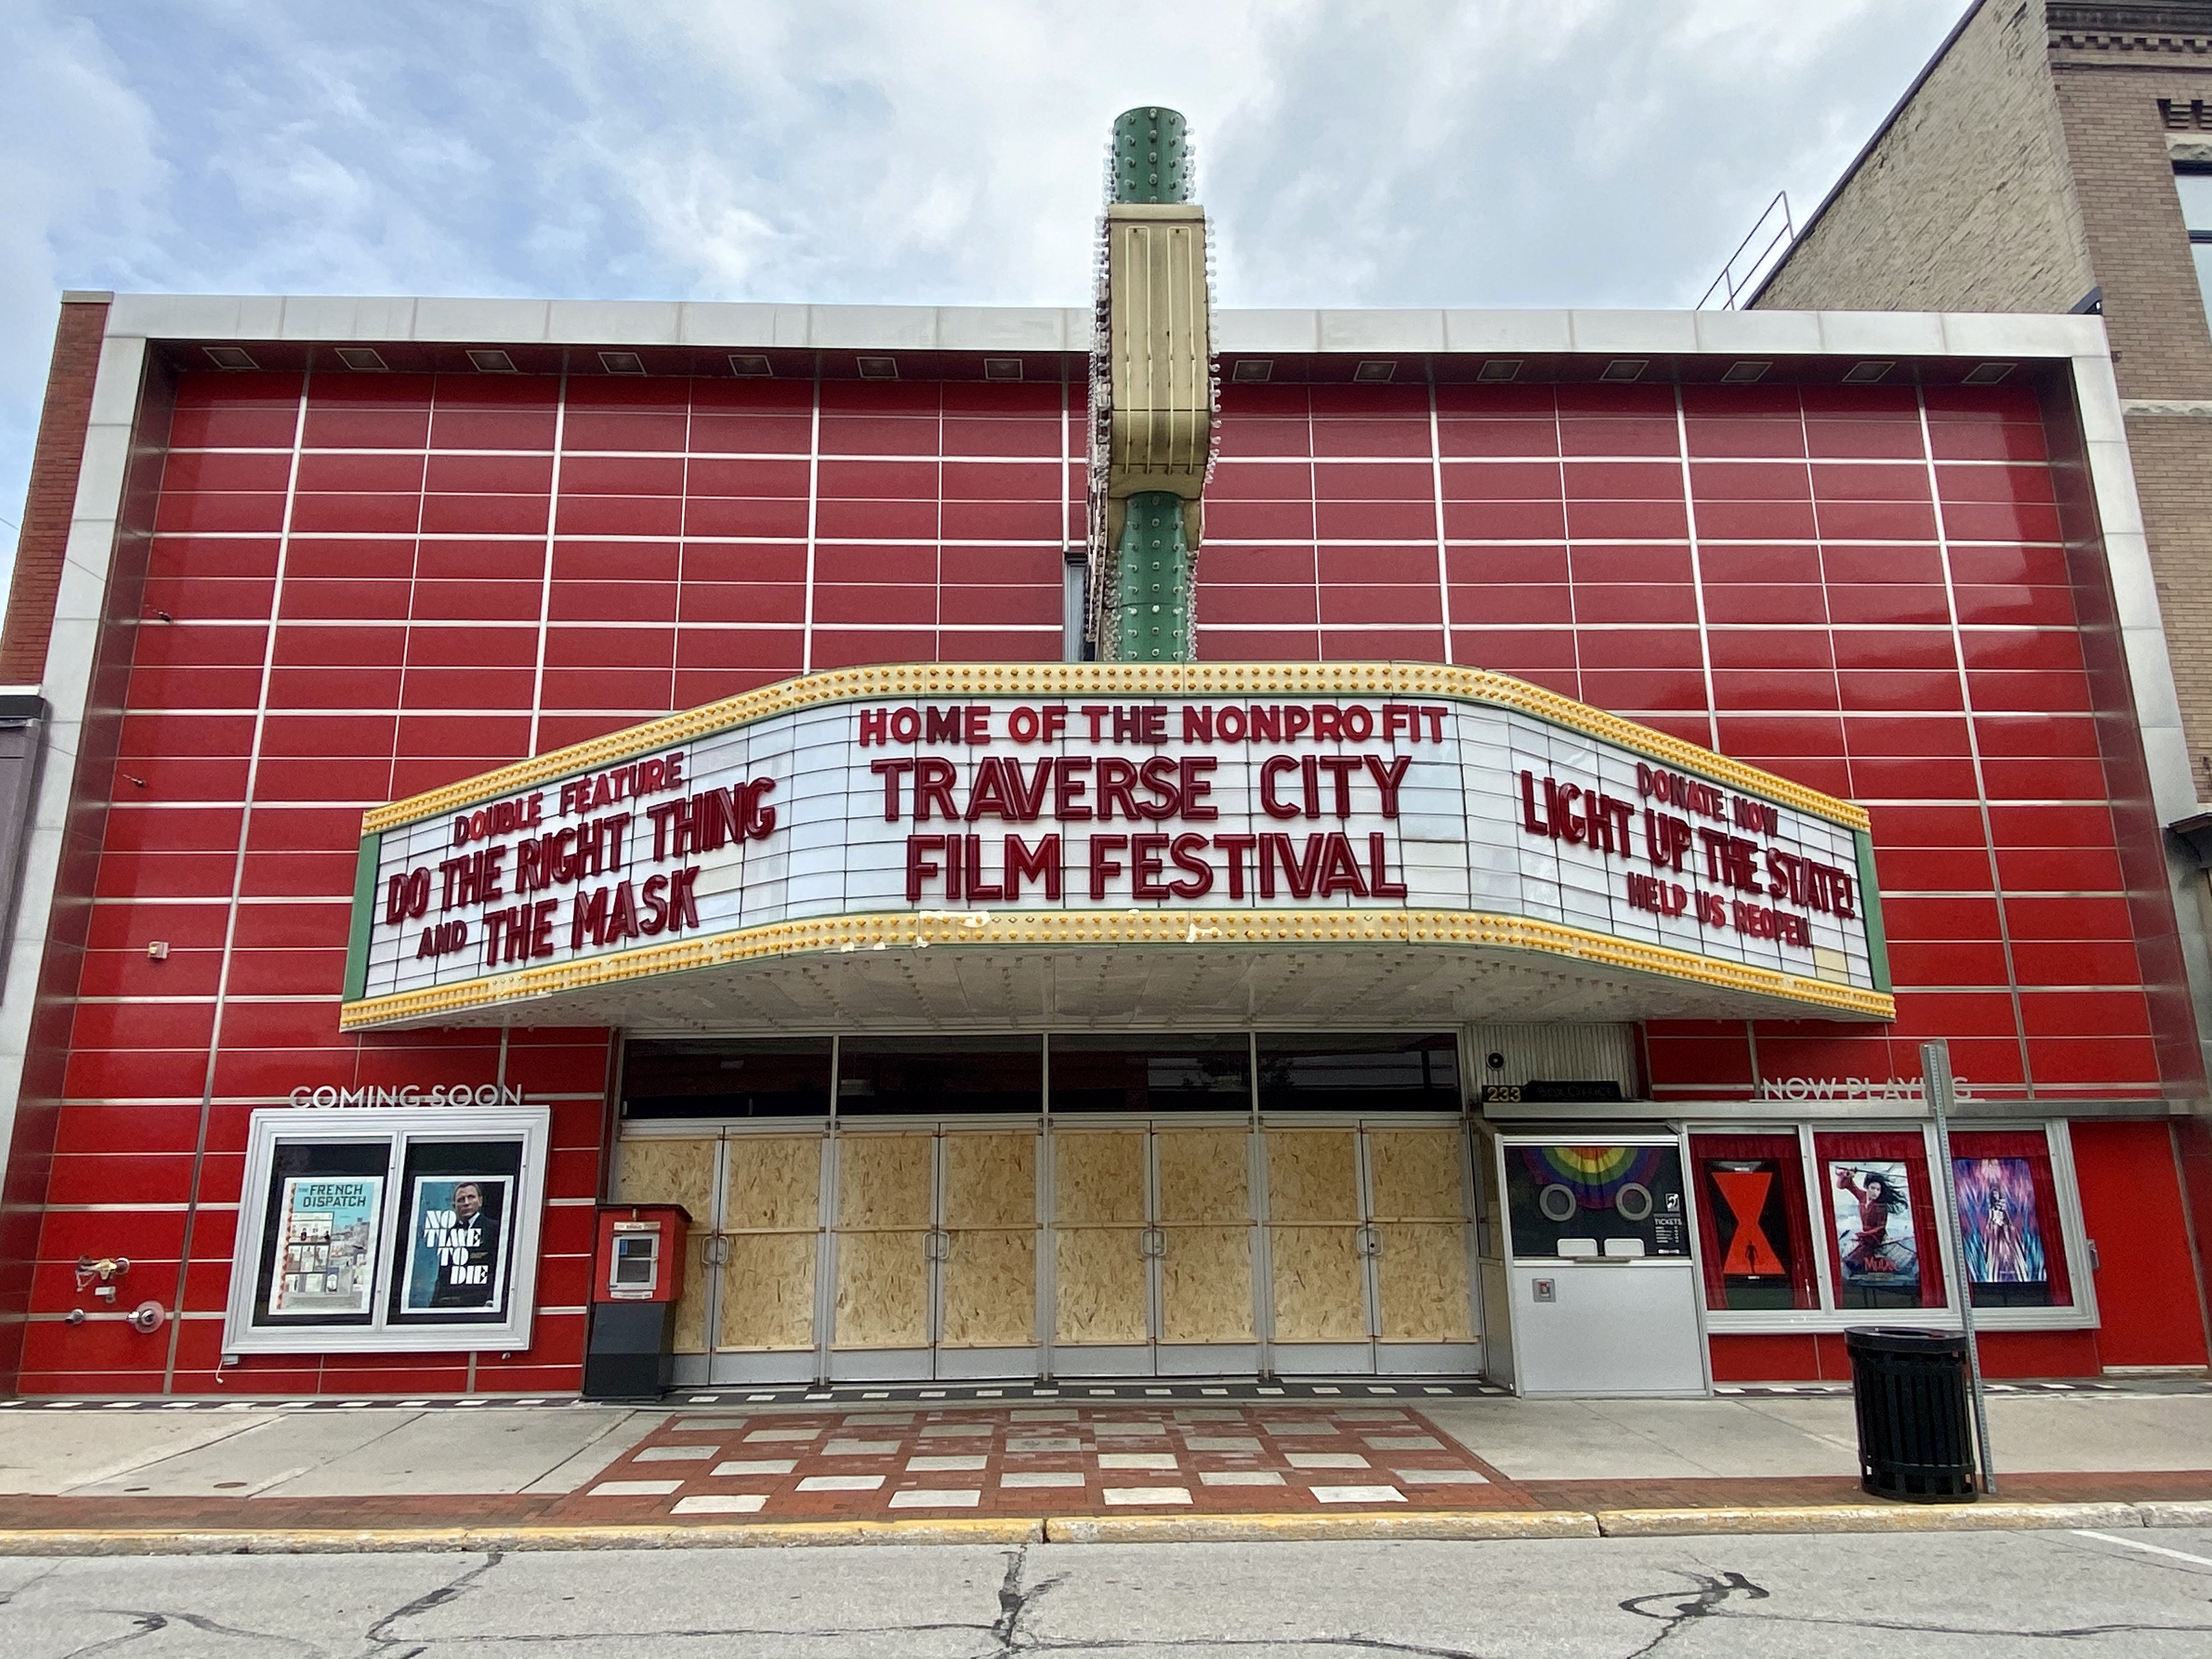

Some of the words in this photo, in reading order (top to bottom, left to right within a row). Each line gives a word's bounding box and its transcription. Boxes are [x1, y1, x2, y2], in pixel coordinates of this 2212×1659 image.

[860, 706, 991, 746] HOME
[1008, 706, 1067, 743] OF
[1081, 706, 1167, 744] THE
[1183, 704, 1448, 744] NONPROFIT
[453, 792, 543, 847] DOUBLE
[558, 751, 684, 818] FEATURE
[871, 755, 1218, 822] TRAVERSE
[1261, 755, 1412, 820] CITY
[1637, 761, 1726, 822] DONATE
[1733, 795, 1778, 838] NOW
[386, 866, 430, 926] DO
[439, 844, 507, 911] THE
[515, 812, 630, 894] RIGHT
[647, 776, 777, 862] THING
[1520, 770, 1634, 859] LIGHT
[1644, 808, 1691, 873] UP
[1698, 826, 1763, 895] THE
[1766, 847, 1855, 919] STATE!
[906, 833, 1060, 901] FILM
[1090, 832, 1408, 899] FESTIVAL
[416, 919, 467, 960] AND
[482, 898, 558, 967] THE
[571, 865, 701, 950] MASK
[1627, 871, 1688, 918] HELP
[1694, 889, 1726, 928] US
[1733, 899, 1812, 948] REOPEN
[290, 1085, 421, 1109] COMING
[430, 1084, 522, 1107] SOON
[1487, 1086, 1521, 1102] 233
[1762, 1077, 1837, 1101] NOW
[1846, 1076, 1972, 1102] PLAYIG
[303, 1196, 367, 1207] DISPATCH
[309, 1184, 364, 1196] FRENCH
[425, 1210, 457, 1229] NO
[423, 1228, 482, 1248] TIME
[437, 1247, 469, 1266] TO
[450, 1265, 489, 1284] DIE
